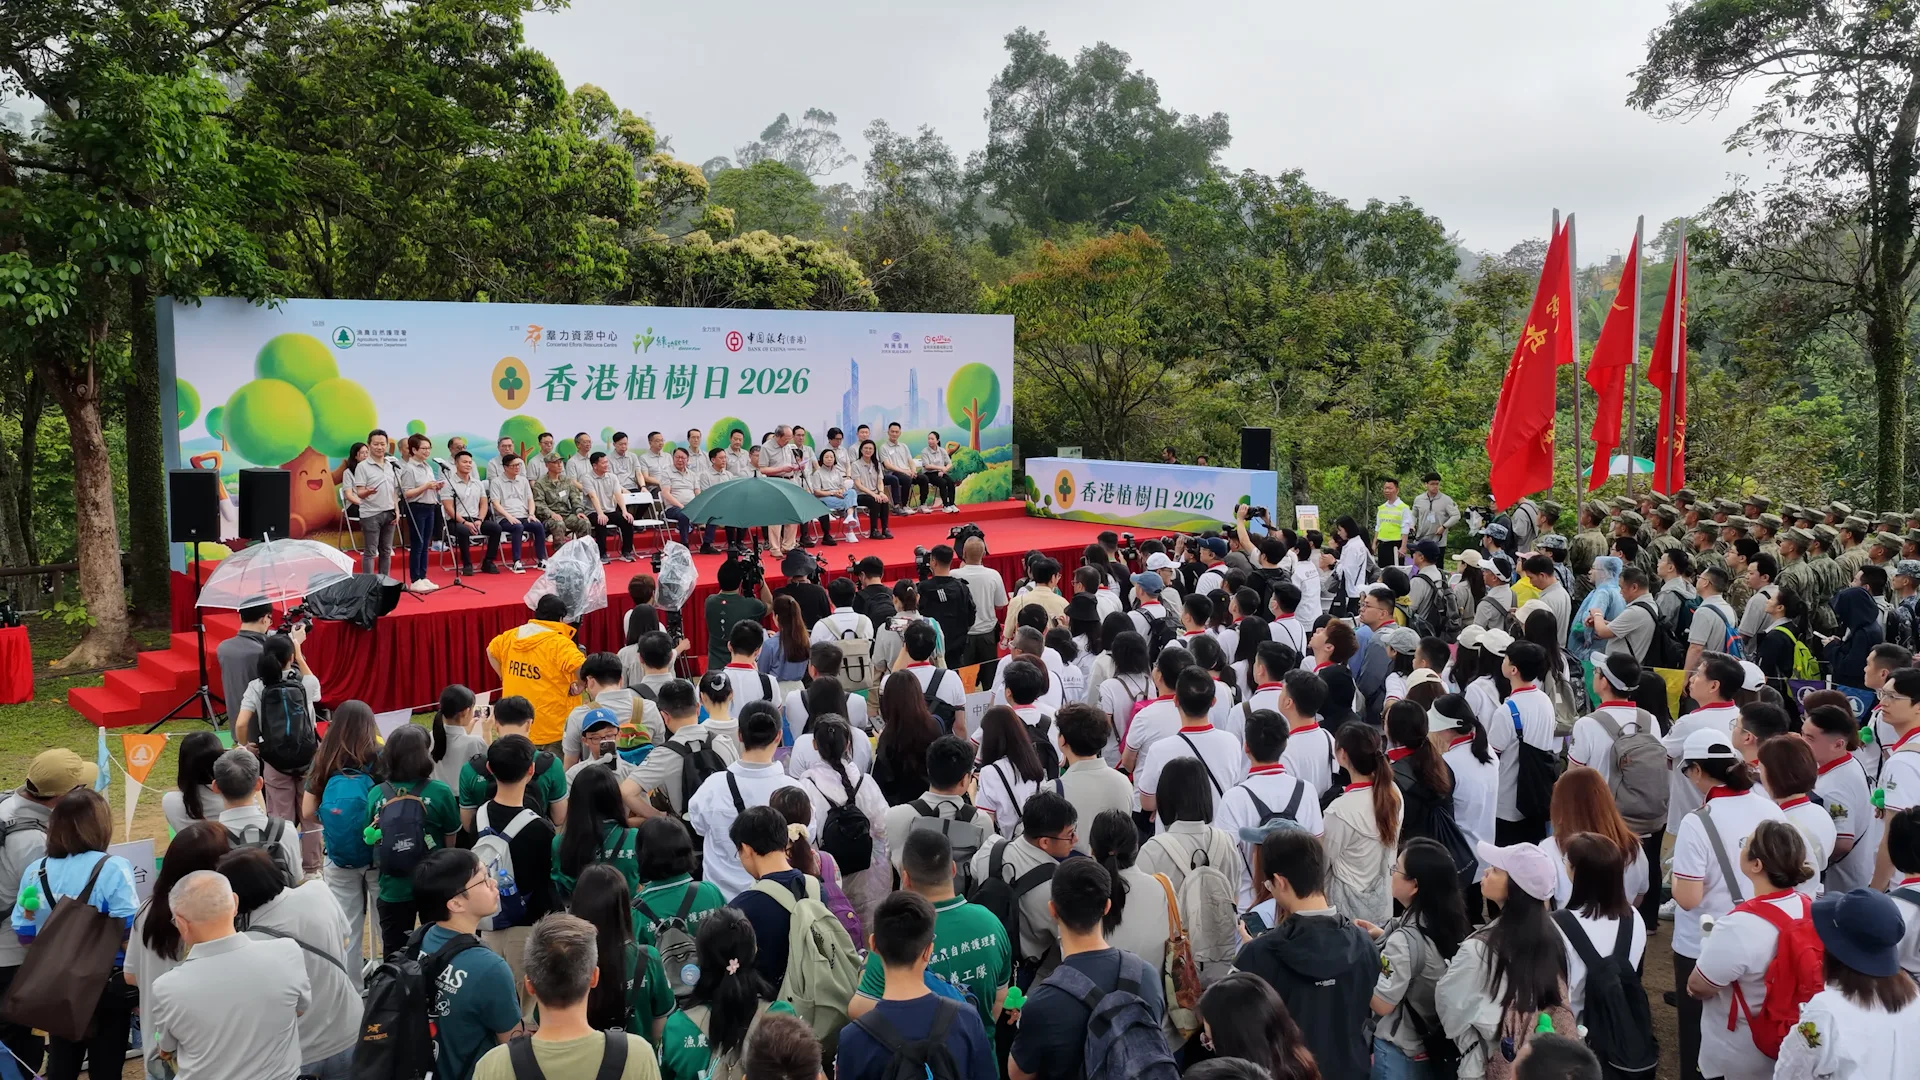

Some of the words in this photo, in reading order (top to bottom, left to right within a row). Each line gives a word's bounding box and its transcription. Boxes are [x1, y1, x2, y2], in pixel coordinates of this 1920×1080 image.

[535, 363, 730, 409] 香港植樹日
[737, 367, 811, 395] 2026
[1080, 481, 1169, 512] 香港植樹日
[1172, 490, 1215, 511] 2026
[508, 660, 542, 680] PRESS
